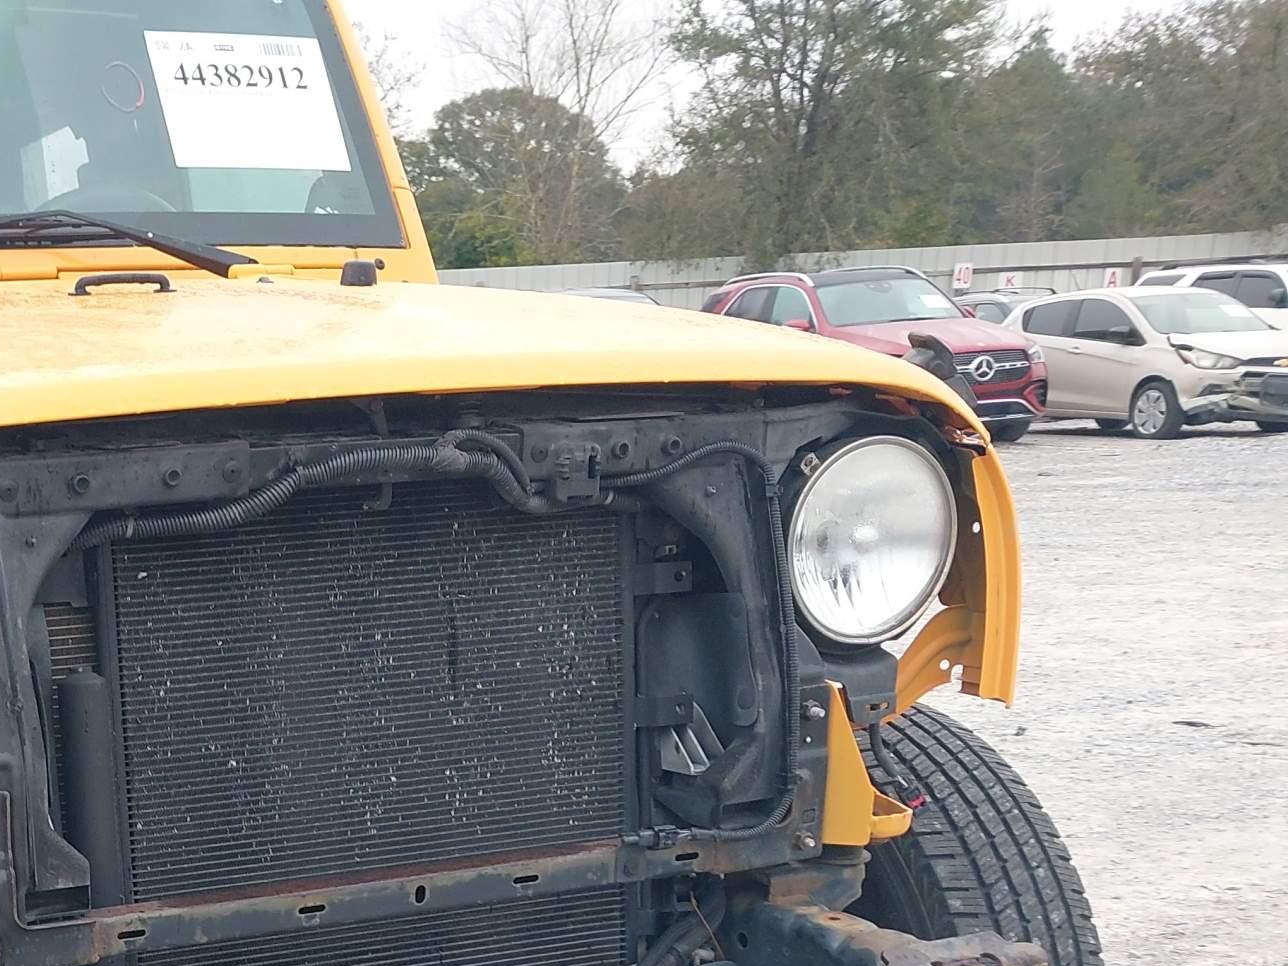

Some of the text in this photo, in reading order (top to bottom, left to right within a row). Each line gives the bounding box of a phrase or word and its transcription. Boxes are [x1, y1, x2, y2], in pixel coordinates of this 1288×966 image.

[173, 62, 309, 90] 44382912
[955, 266, 971, 285] 40
[1005, 275, 1016, 287] K
[1106, 271, 1118, 288] A
